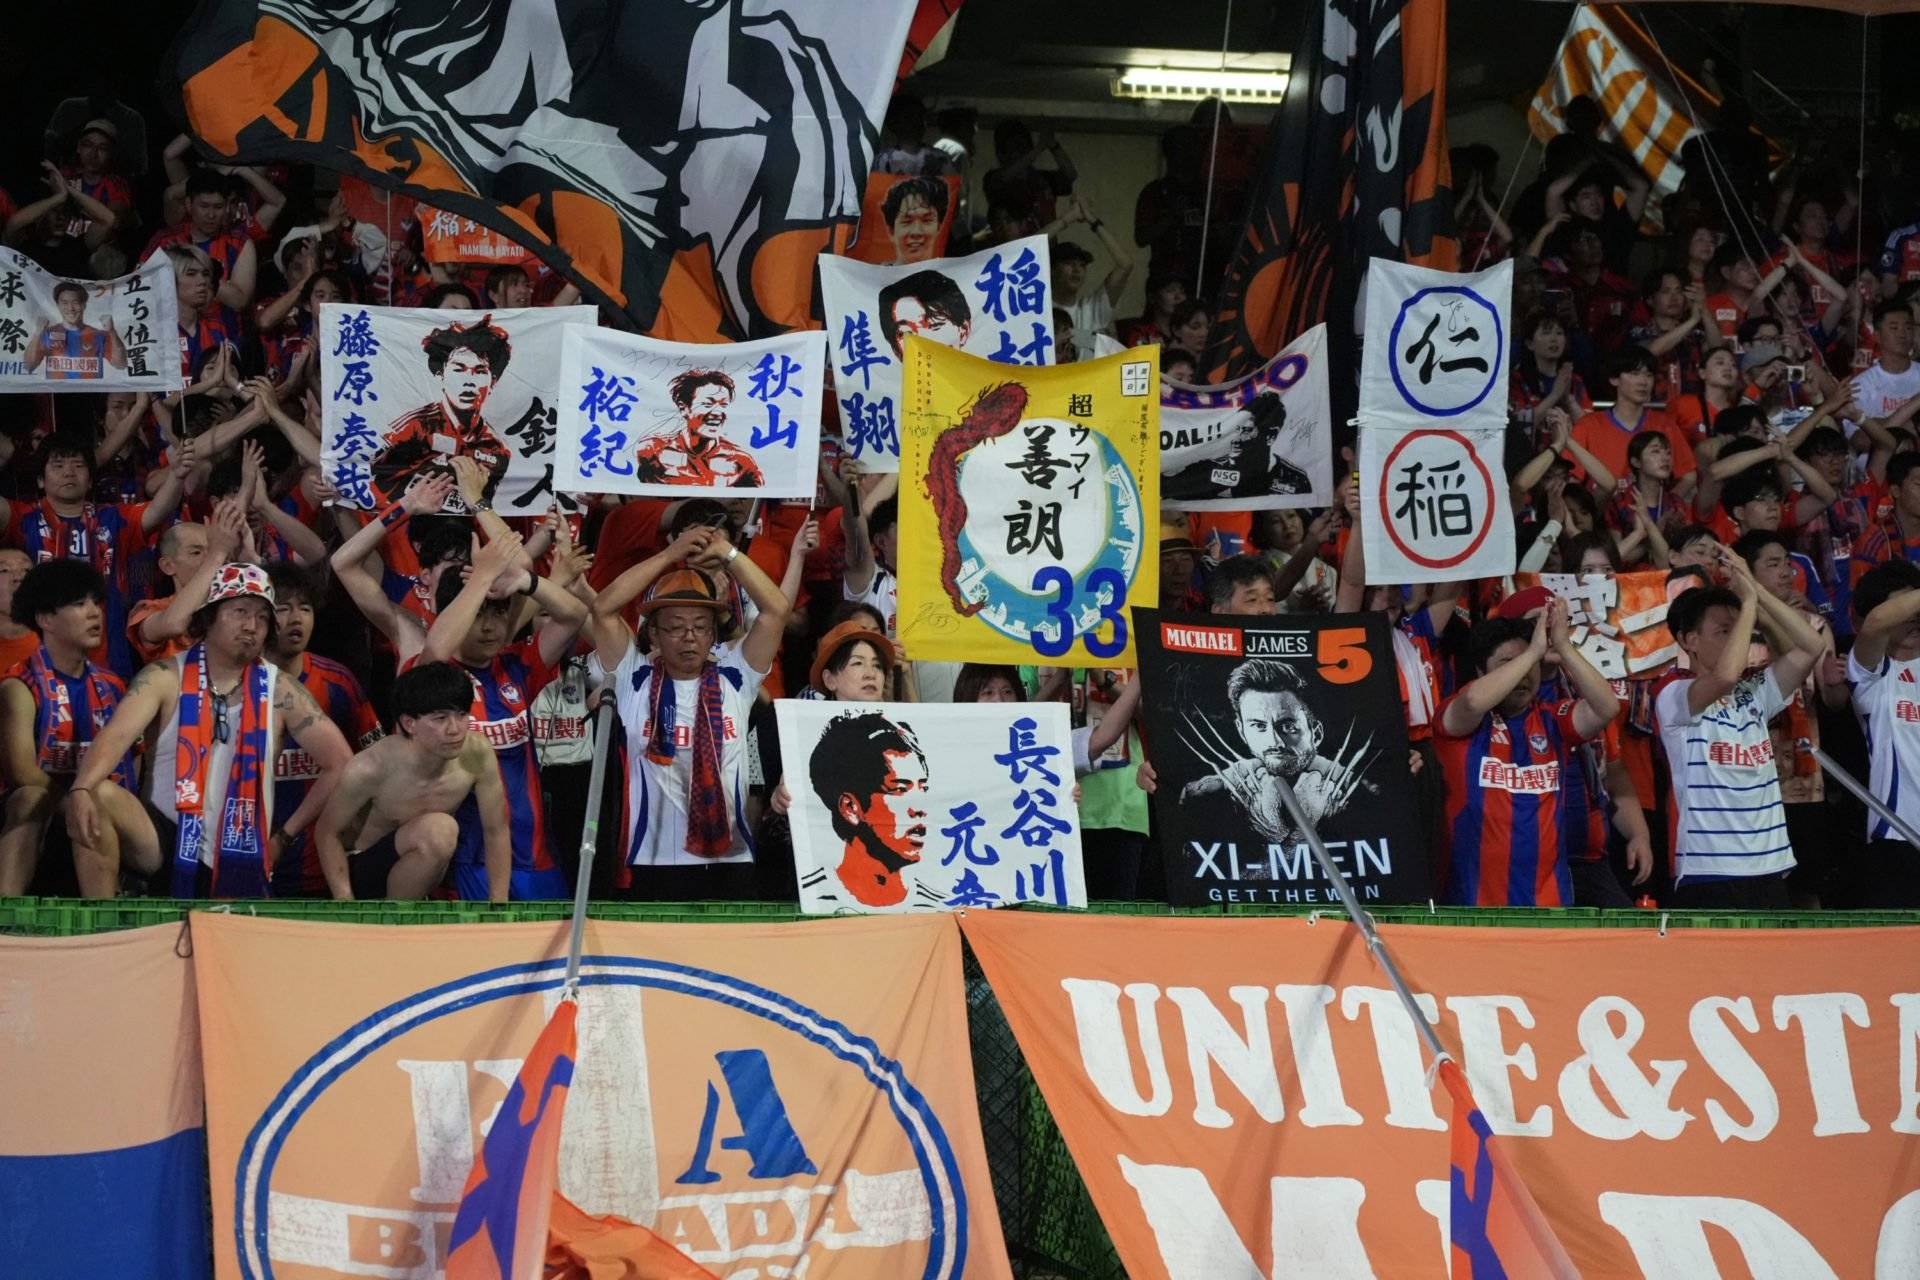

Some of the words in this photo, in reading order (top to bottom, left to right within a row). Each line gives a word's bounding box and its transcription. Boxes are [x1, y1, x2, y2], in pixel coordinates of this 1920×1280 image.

[123, 275, 158, 377] 立ち位置
[1405, 313, 1488, 385] 仁
[332, 310, 381, 508] 藤原奏哉
[578, 366, 639, 477] 裕紀
[747, 353, 803, 449] 秋山
[840, 310, 899, 459] 隼翔
[1068, 394, 1094, 499] 超ウマイ
[1160, 422, 1222, 450] OAL!!
[1213, 470, 1238, 482] NSG
[1004, 425, 1071, 561] 善朗
[1395, 461, 1473, 540] 稲
[69, 529, 88, 555] 31
[1030, 566, 1128, 659] 33
[1166, 628, 1237, 651] MICHAEL
[1246, 636, 1308, 653] JAMES
[1316, 627, 1373, 685] 5
[994, 717, 1072, 906] 長谷川
[1191, 838, 1392, 881] XI-MEN
